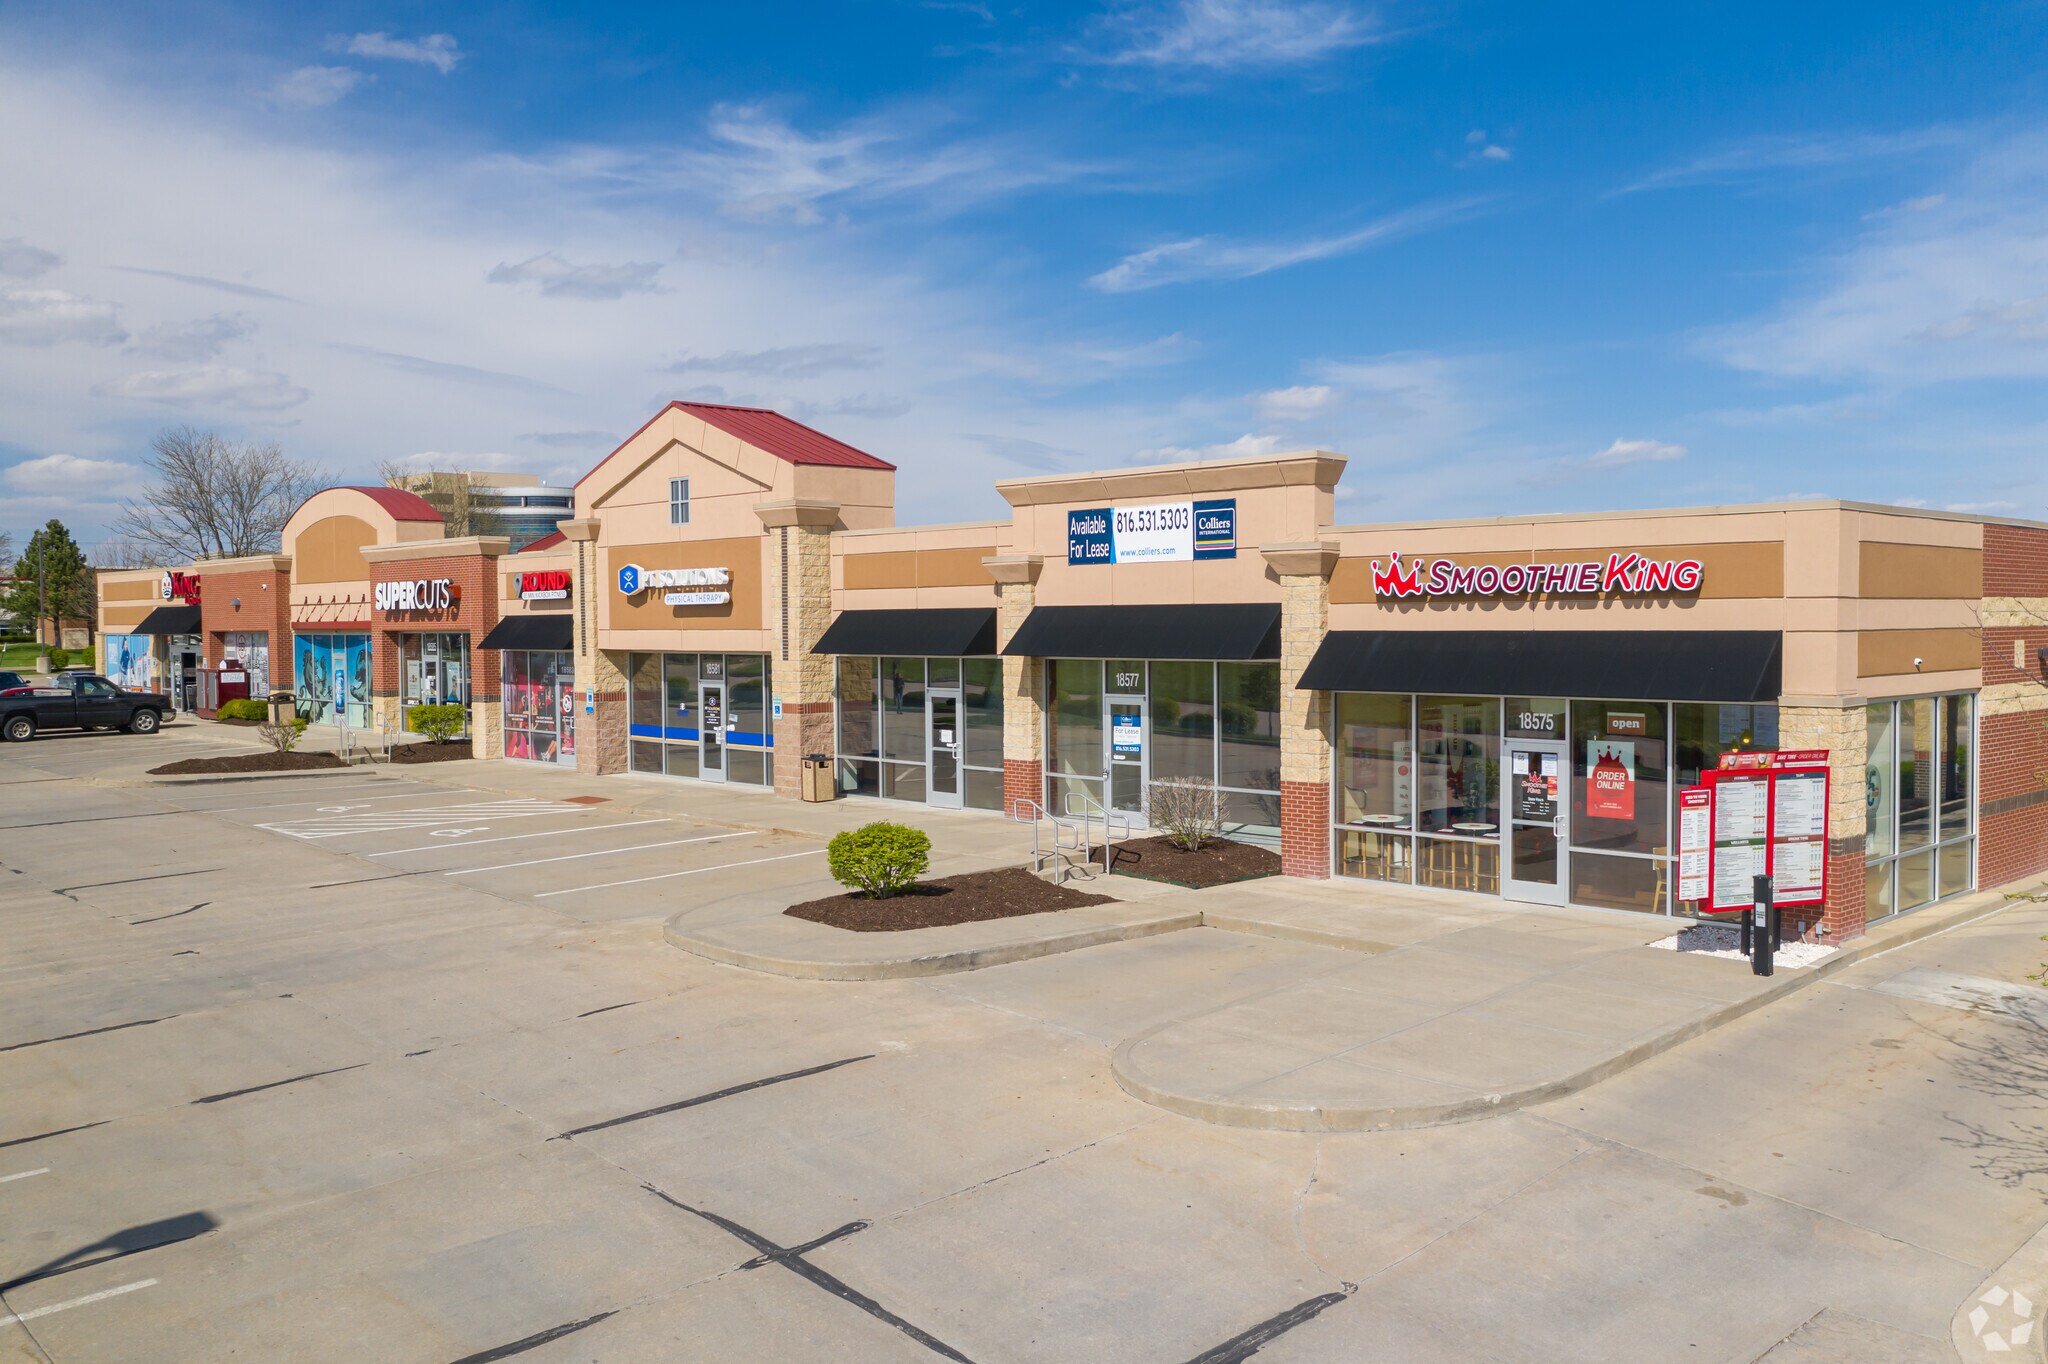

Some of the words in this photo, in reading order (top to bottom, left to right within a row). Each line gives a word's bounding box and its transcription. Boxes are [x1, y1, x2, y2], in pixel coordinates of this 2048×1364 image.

[1070, 515, 1106, 535] Available
[1116, 508, 1188, 533] 816.531.5303
[1198, 517, 1230, 530] Colliers
[1070, 540, 1084, 558] For
[1086, 539, 1110, 558] Lease
[1120, 547, 1176, 556] www.colliers.com
[1426, 559, 1601, 596] SMOOTHIE
[375, 578, 451, 610] SUPERCUTS
[666, 595, 694, 604] PHYSICAL
[696, 594, 722, 602] THERAPY
[1116, 672, 1139, 686] 18577
[1519, 712, 1554, 730] 18575
[1612, 720, 1640, 730] open
[1596, 771, 1626, 781] ORDER
[1596, 780, 1626, 790] ONLINE
